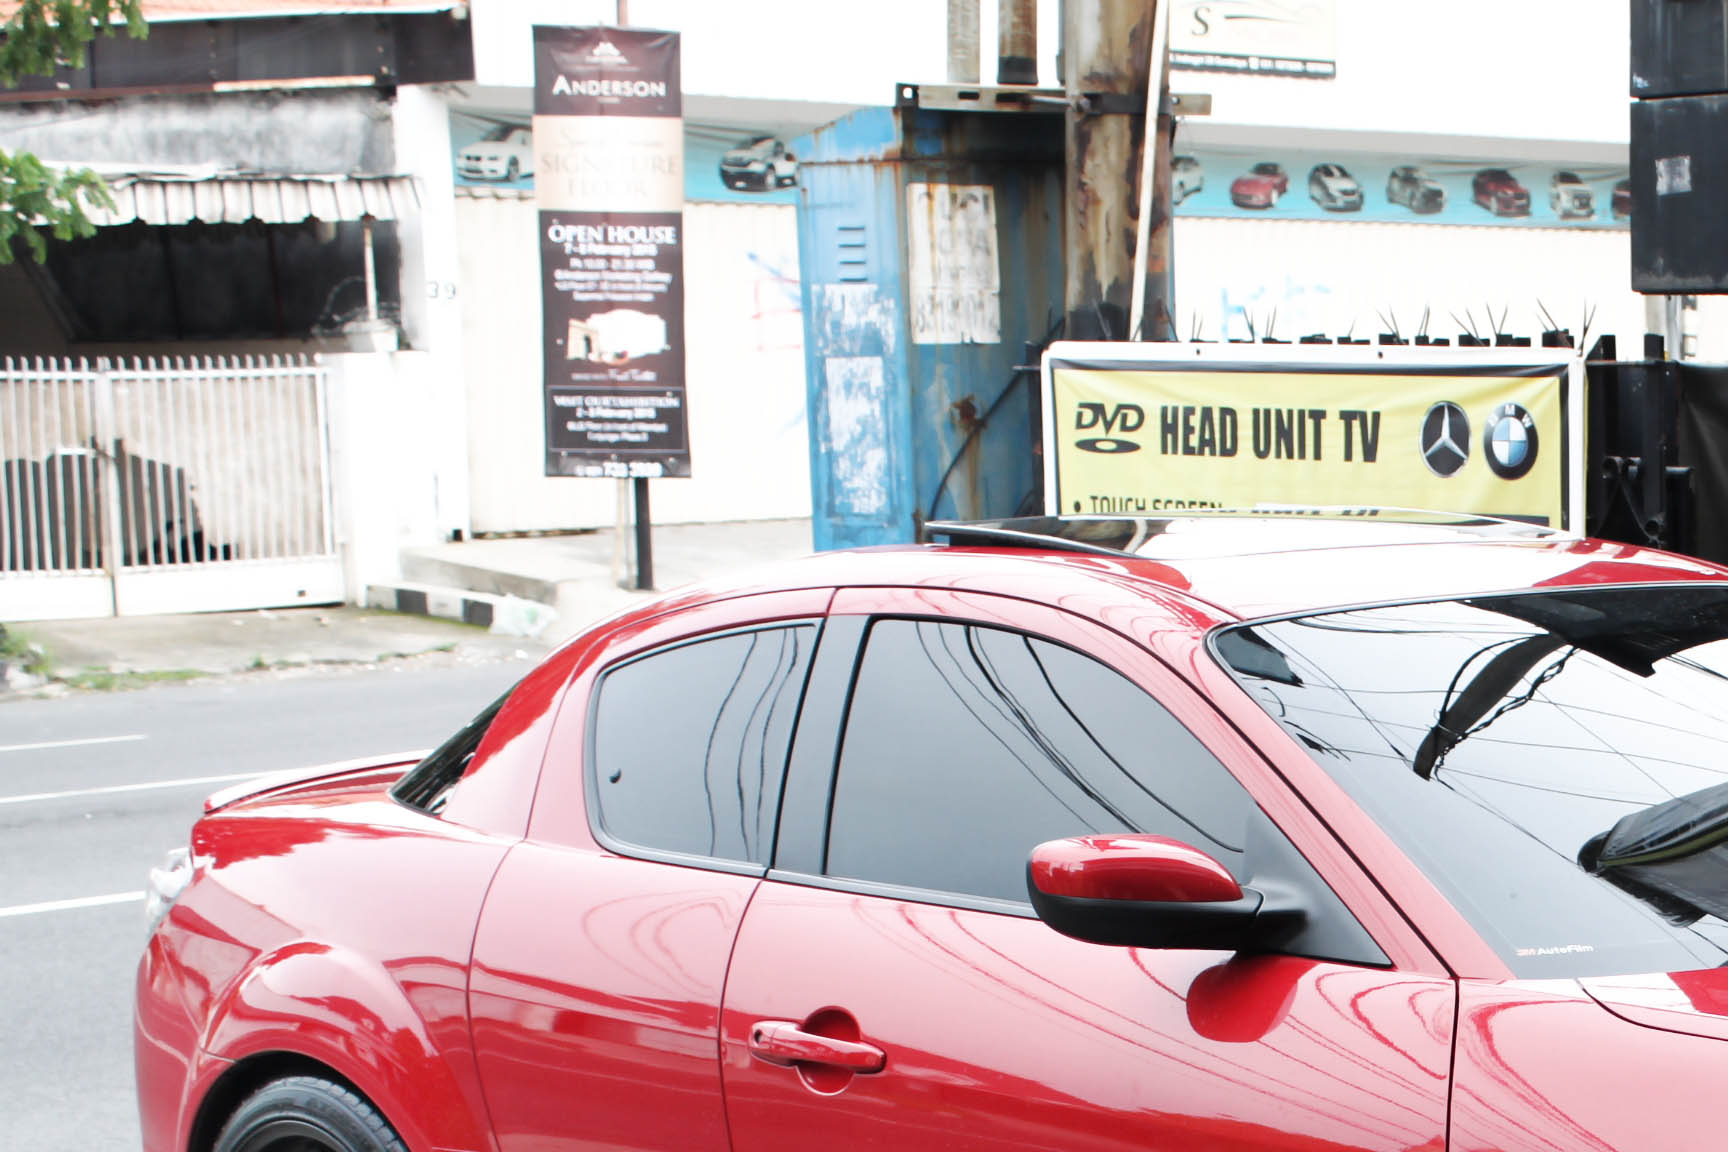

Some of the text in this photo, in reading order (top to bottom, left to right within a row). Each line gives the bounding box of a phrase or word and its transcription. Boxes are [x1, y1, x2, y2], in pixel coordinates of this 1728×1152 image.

[552, 74, 667, 97] ANDERSON
[548, 225, 677, 244] OPEN HOUSE
[1075, 402, 1381, 463] DVD HEAD UNIT TV
[1537, 943, 1594, 956] AutoFilm
